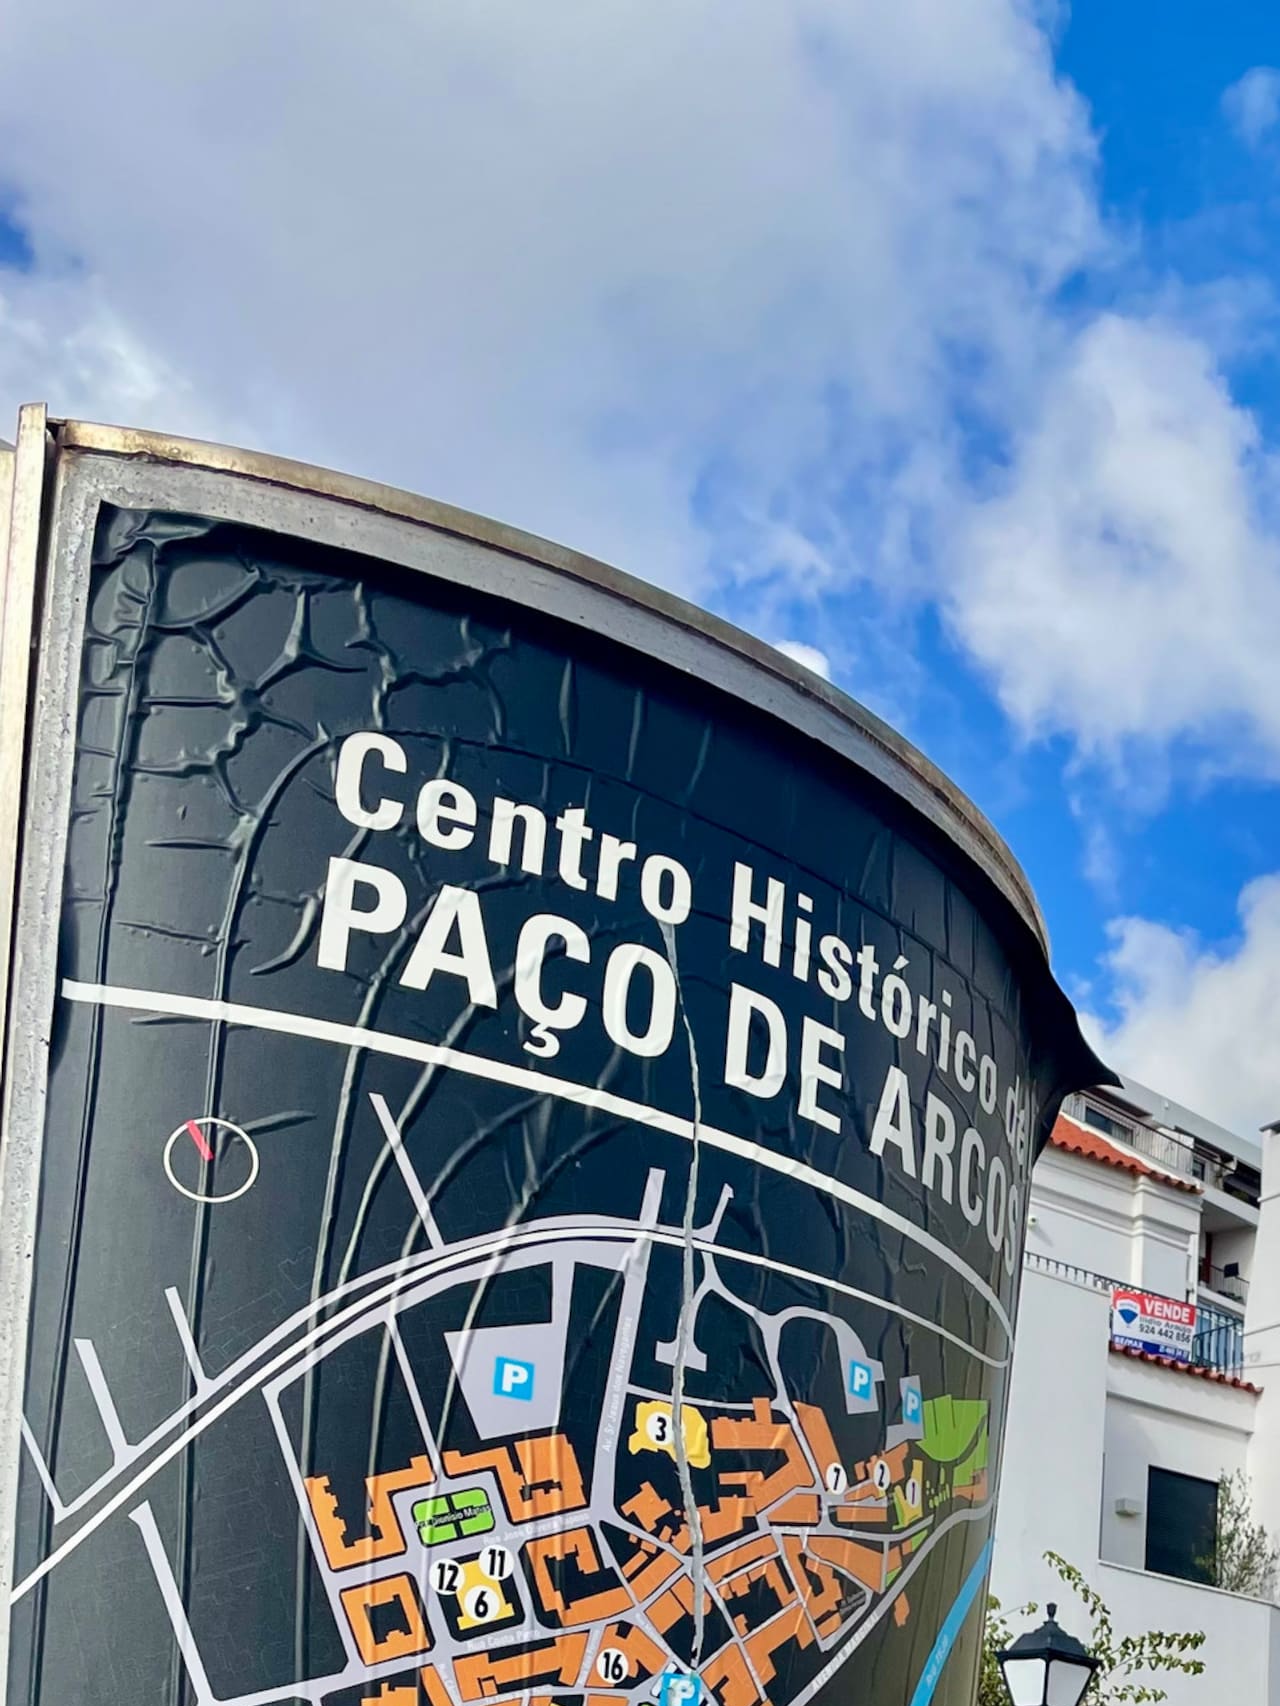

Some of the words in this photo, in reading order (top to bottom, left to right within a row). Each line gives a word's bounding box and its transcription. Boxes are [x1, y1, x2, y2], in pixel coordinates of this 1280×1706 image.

[335, 731, 693, 925] Centro
[729, 860, 999, 1117] Histórico
[316, 856, 679, 1059] PAÇO
[722, 981, 846, 1135] DE
[867, 1064, 1021, 1279] ARCOS
[1144, 1298, 1191, 1323] VENDE
[1157, 1327, 1174, 1340] 442
[437, 1562, 459, 1591] 12
[488, 1549, 505, 1577] 11
[474, 1590, 488, 1618] 6
[603, 1652, 623, 1680] 16
